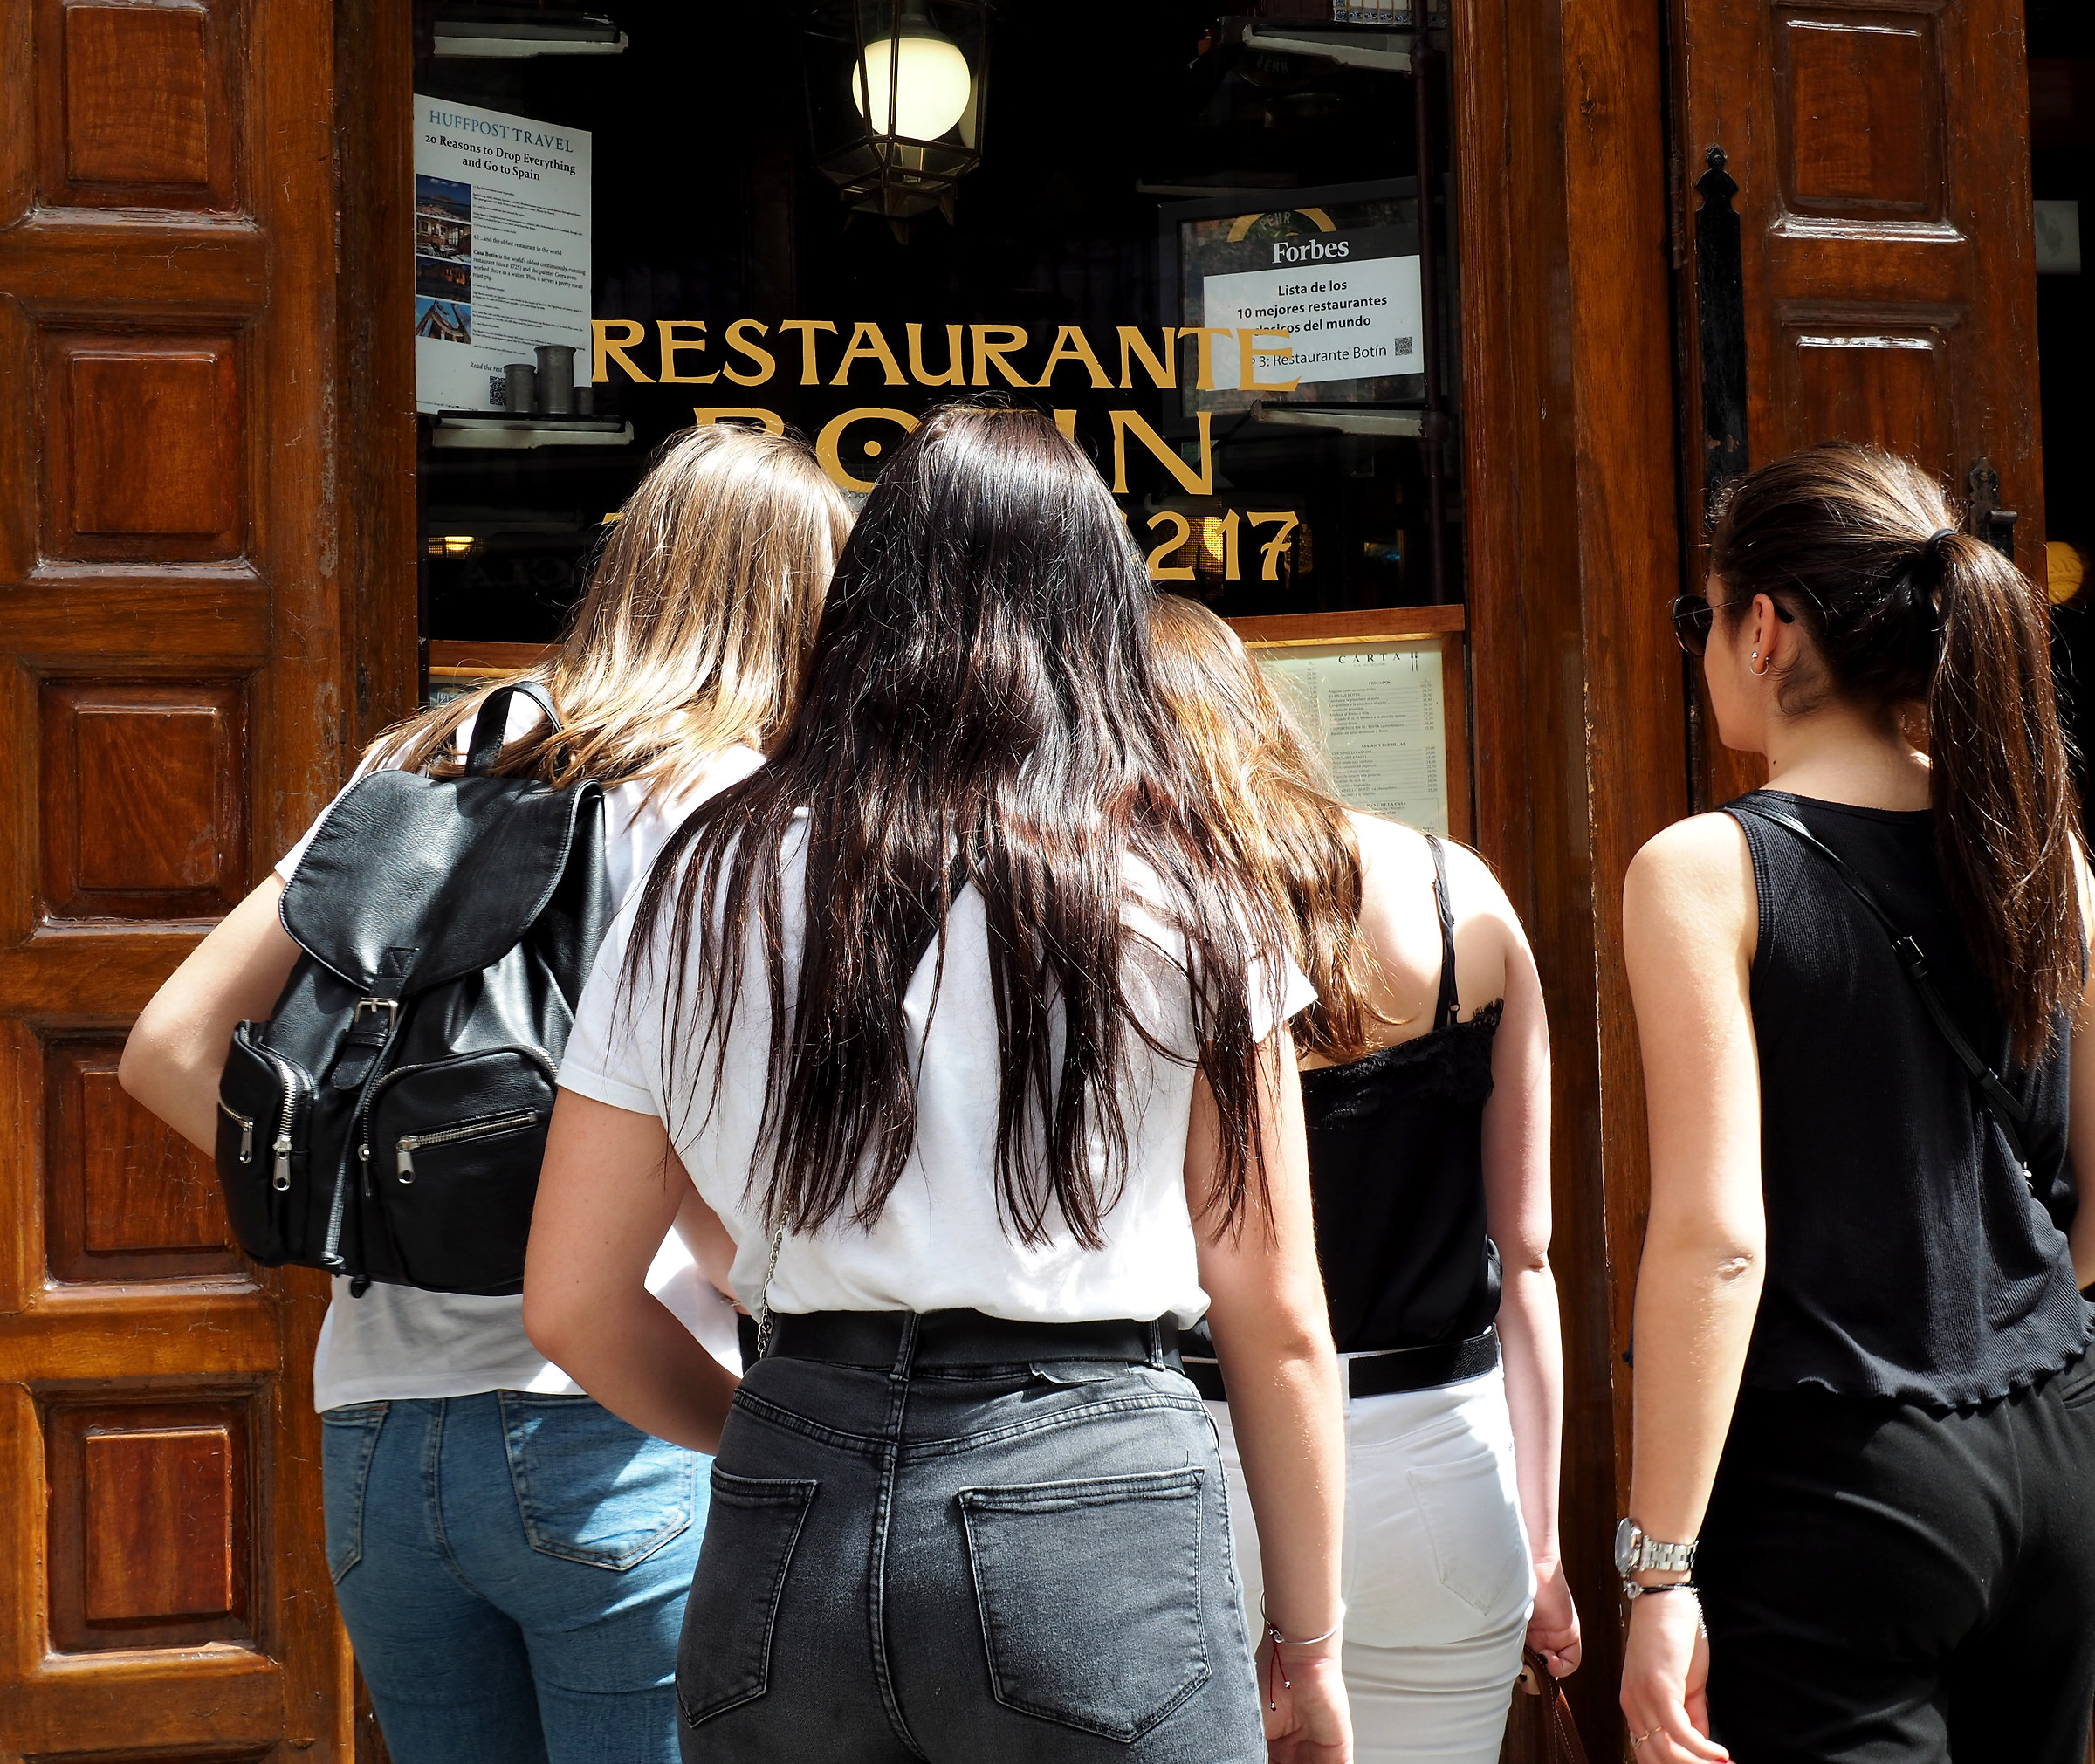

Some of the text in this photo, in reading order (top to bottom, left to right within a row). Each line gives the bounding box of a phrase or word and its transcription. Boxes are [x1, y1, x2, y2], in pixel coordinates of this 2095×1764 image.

[429, 110, 574, 153] HUFFPOST TRAVEL
[425, 134, 576, 176] 20 Reasons to Drop Everything
[463, 156, 540, 181] and Go to Spain
[515, 242, 536, 251] restaurant
[1272, 238, 1350, 264] Forbes
[1278, 280, 1348, 297] Lista de los
[1237, 296, 1388, 319] 10 mejores restaurantes
[1303, 319, 1324, 332] del
[1326, 315, 1372, 331] mundo
[470, 361, 483, 370] Read
[591, 319, 1300, 391] RESTAURANTE
[1273, 349, 1350, 367] Restaurante
[1353, 344, 1388, 360] Botín
[1118, 509, 1299, 580] 217
[1338, 653, 1401, 664] CARTA
